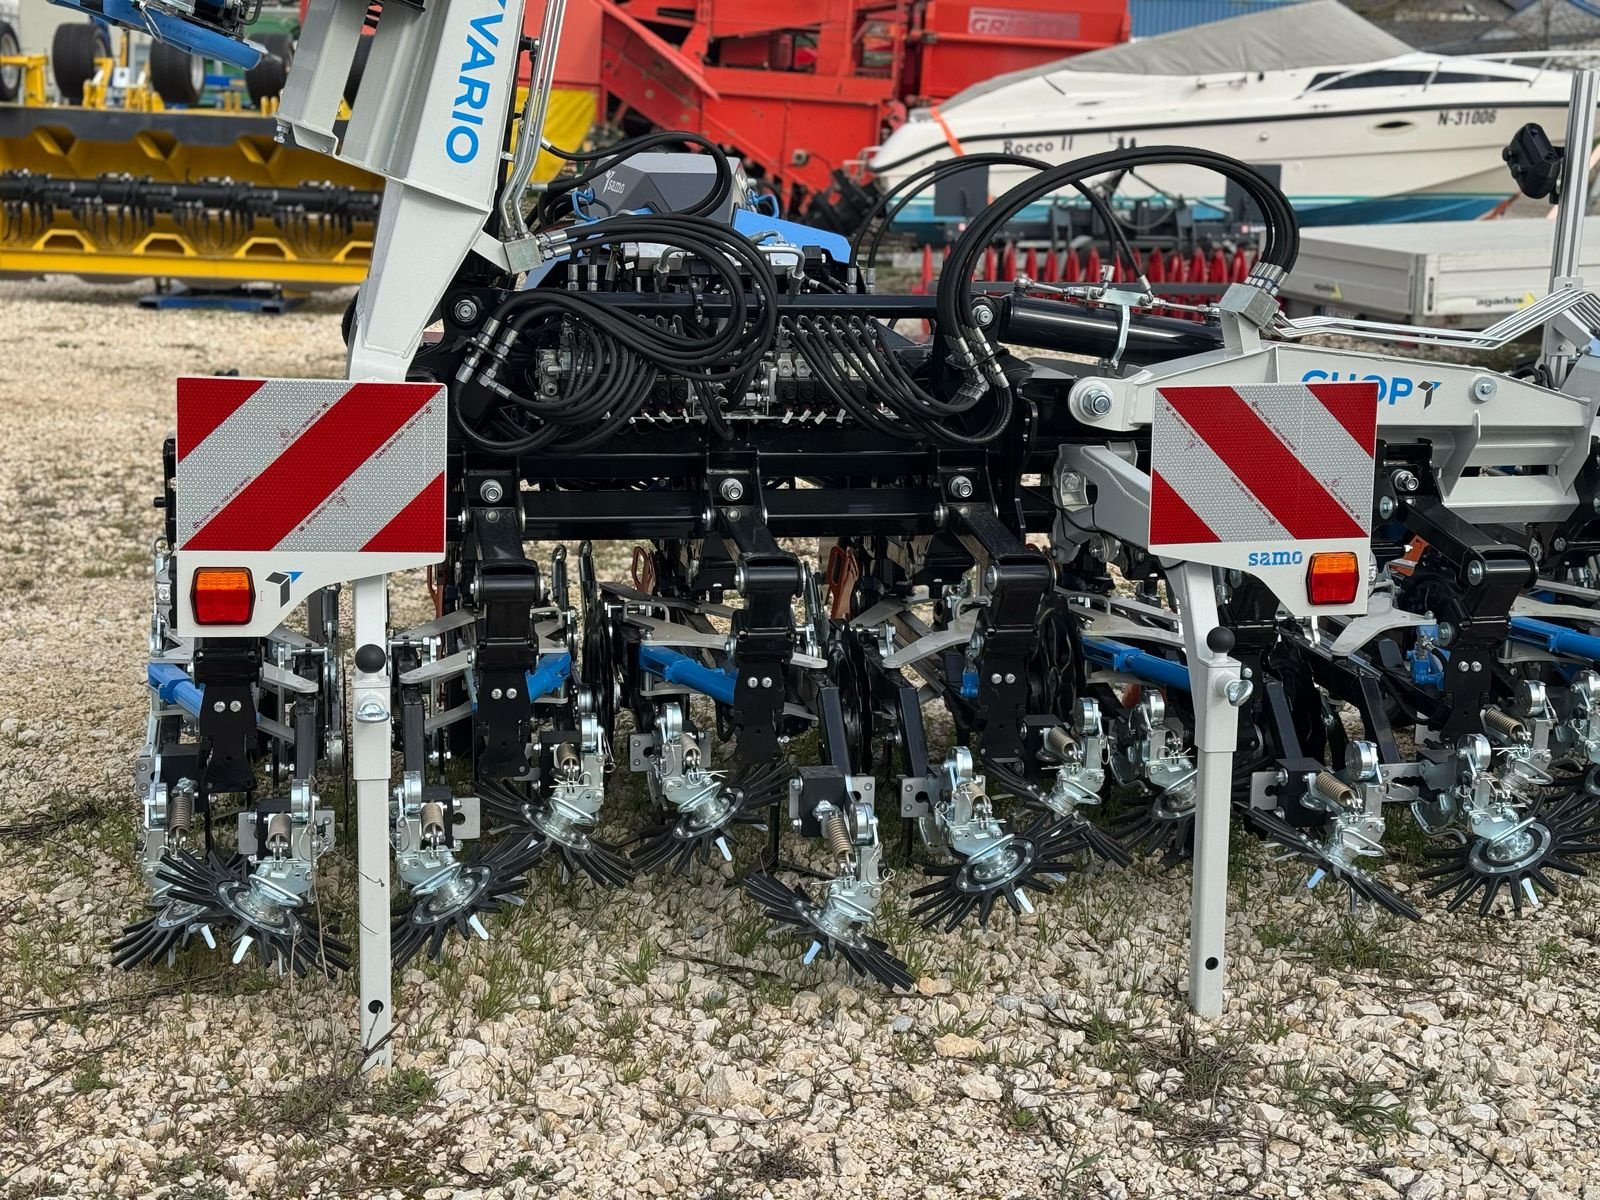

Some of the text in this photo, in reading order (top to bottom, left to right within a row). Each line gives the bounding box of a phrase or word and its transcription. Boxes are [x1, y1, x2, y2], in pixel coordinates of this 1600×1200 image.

[445, 0, 508, 164] VARIO
[1438, 109, 1497, 126] N-31006
[1003, 139, 1054, 155] Rocco
[1247, 550, 1303, 567] samo
